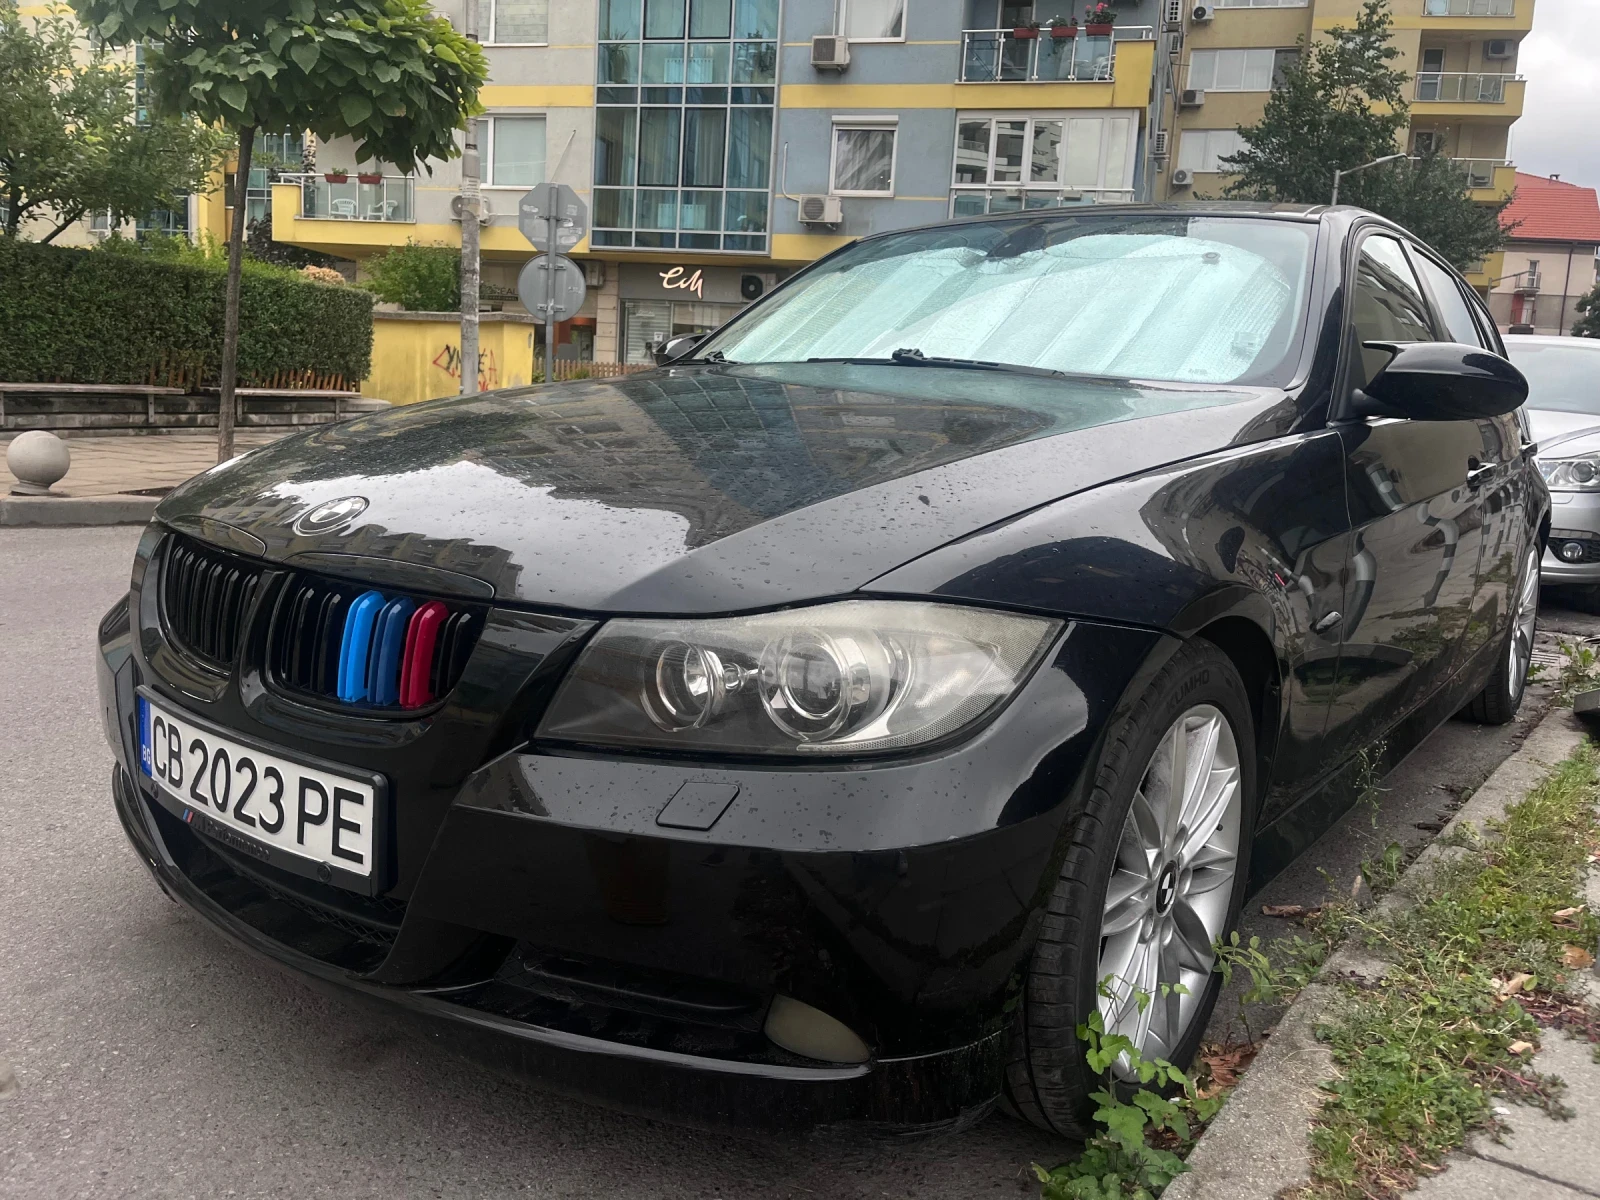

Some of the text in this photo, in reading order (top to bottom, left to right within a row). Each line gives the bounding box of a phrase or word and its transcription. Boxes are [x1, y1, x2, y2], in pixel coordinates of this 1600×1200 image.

[1166, 668, 1210, 714] KUMHO
[142, 744, 151, 765] BG
[189, 738, 285, 834] 2023
[297, 776, 365, 864] PE
